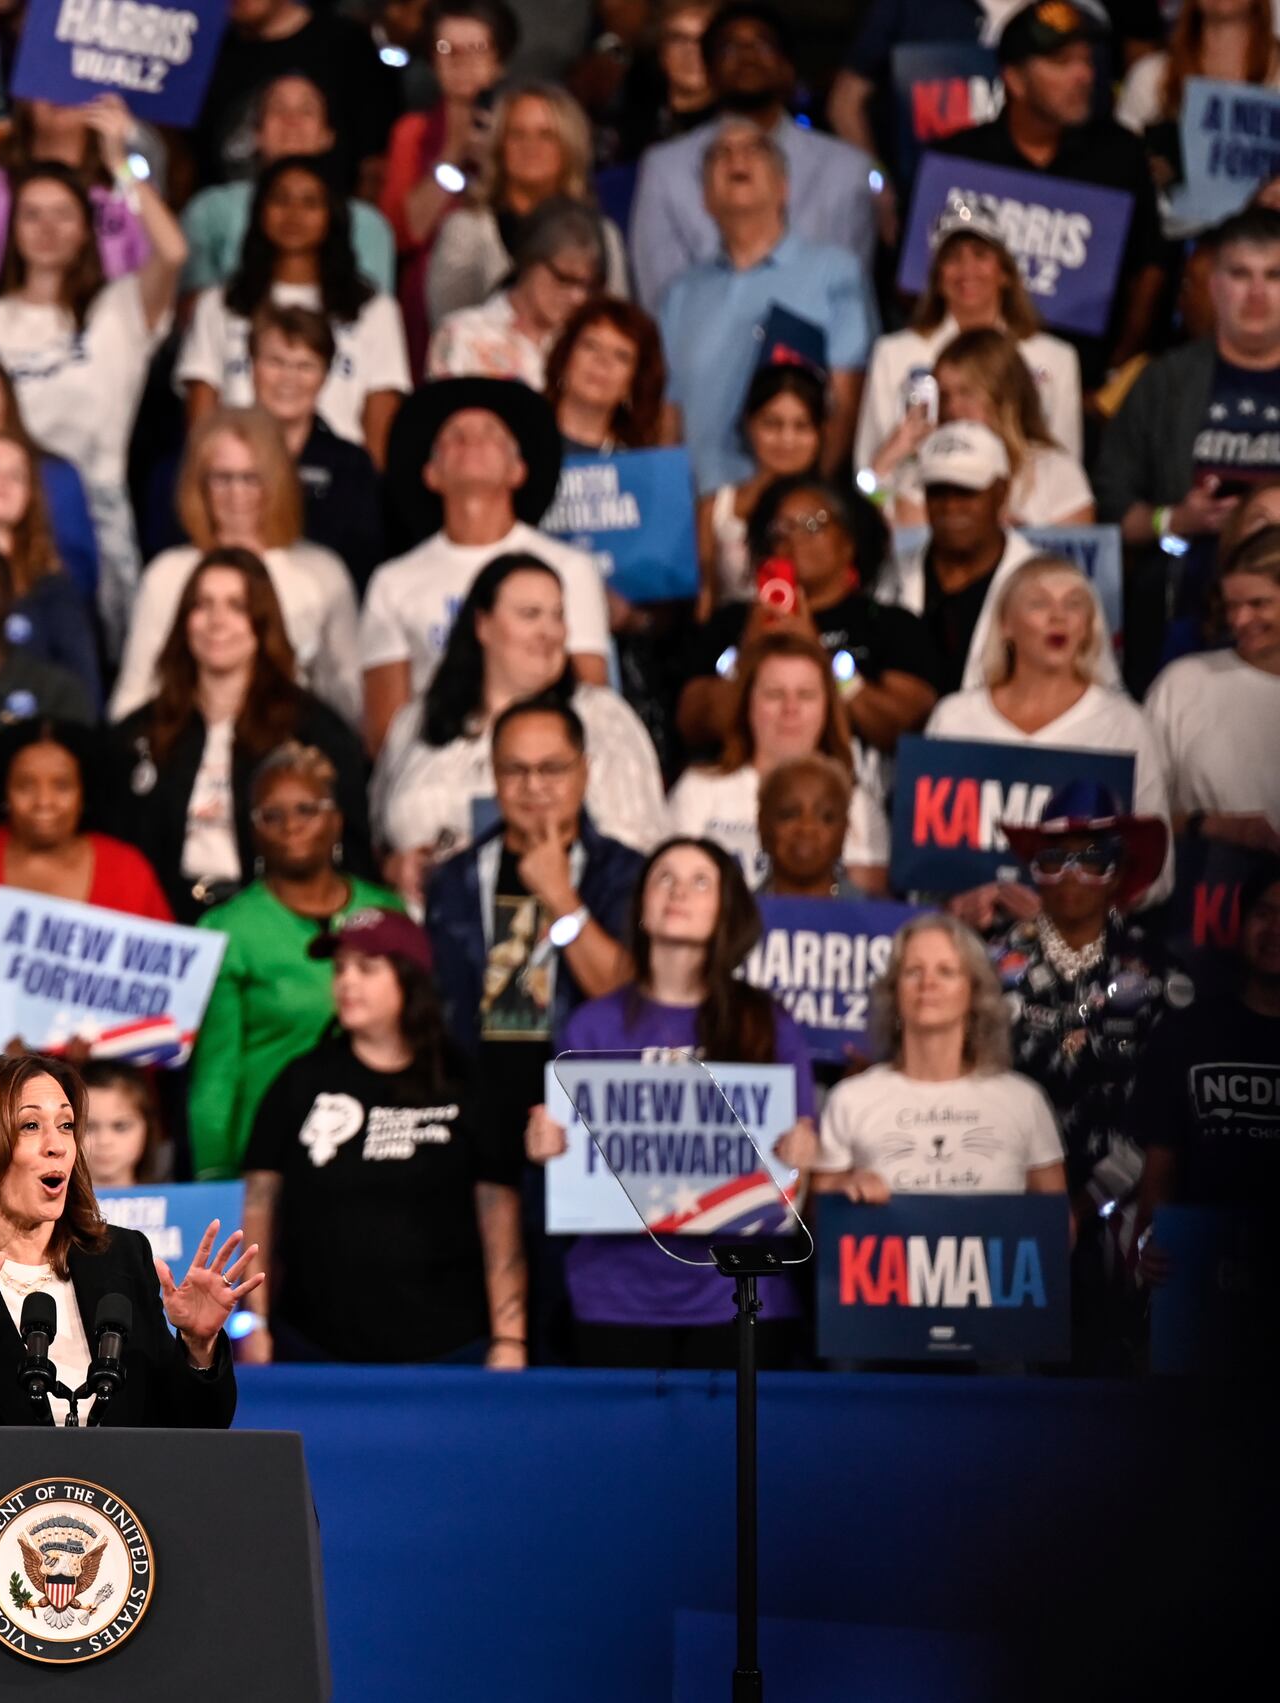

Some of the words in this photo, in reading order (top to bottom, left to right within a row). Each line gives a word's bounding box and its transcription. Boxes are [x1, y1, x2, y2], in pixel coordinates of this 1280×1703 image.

[55, 0, 199, 66] HARRIS
[72, 46, 169, 94] WALZ
[2, 908, 30, 946] A
[35, 914, 115, 965] NEW
[122, 934, 199, 981] WAY
[7, 951, 171, 1018] FORWARD
[573, 1081, 599, 1123] A
[605, 1081, 686, 1123] NEW
[696, 1081, 771, 1126] WAY
[586, 1131, 760, 1176] FORWARD
[838, 1233, 1048, 1308] KAMALA
[35, 1485, 57, 1502] OF
[63, 1485, 95, 1504] THE
[102, 1497, 149, 1575] UNITED
[88, 1587, 147, 1652] STATES
